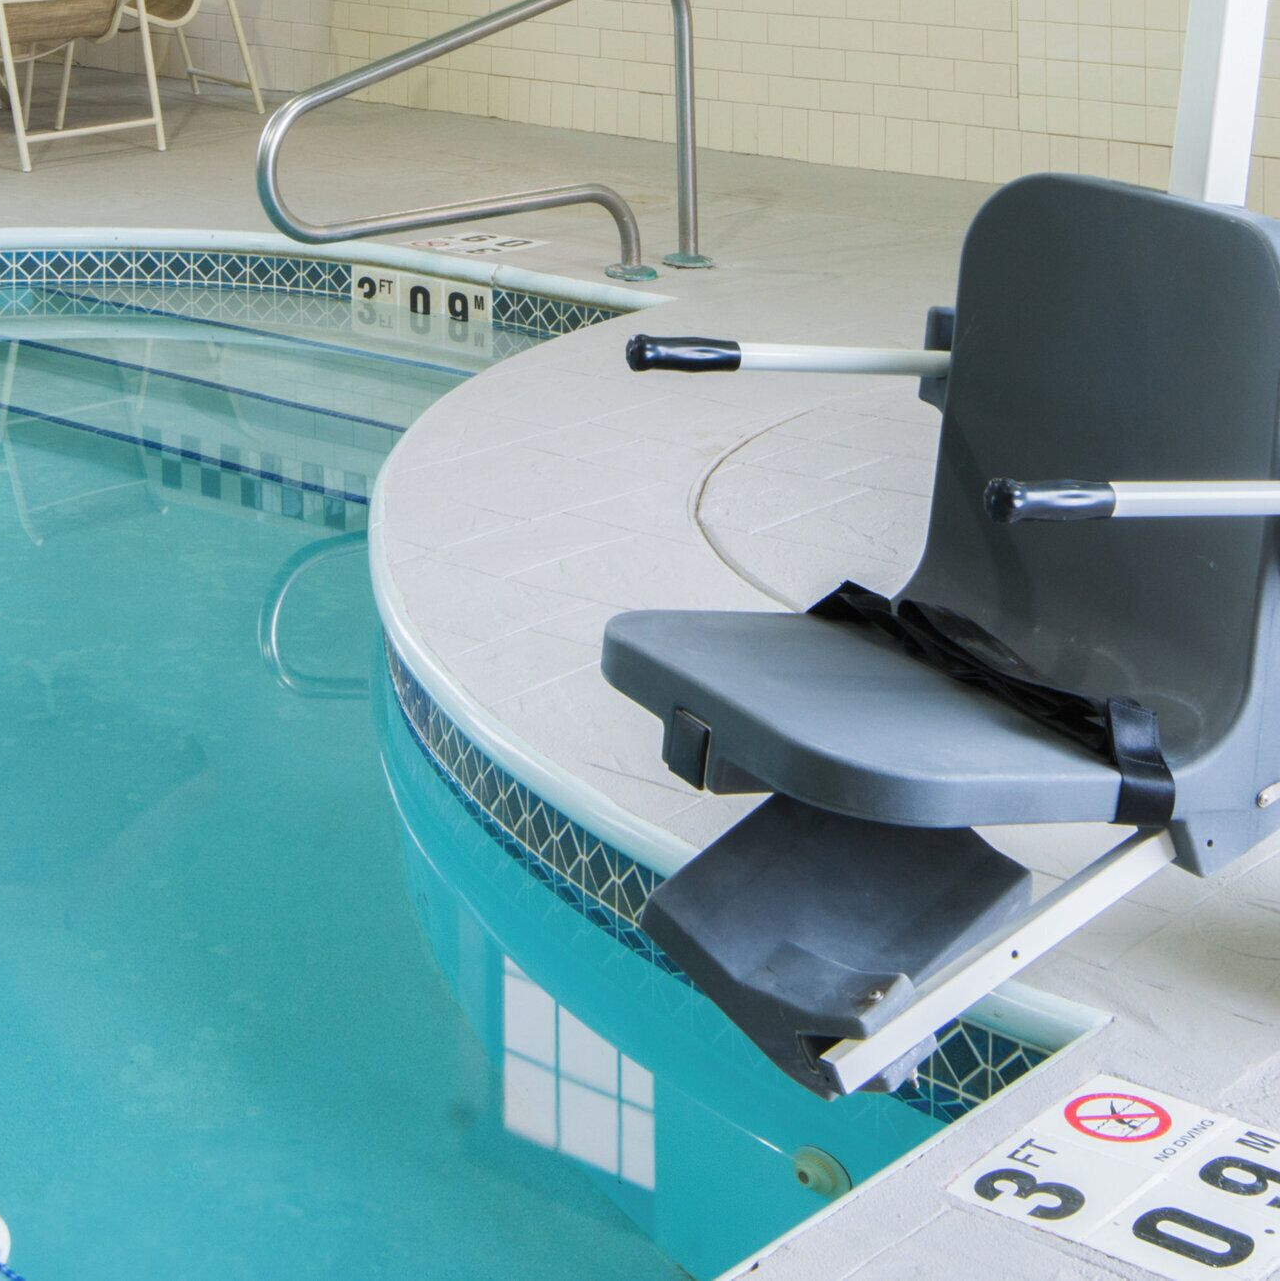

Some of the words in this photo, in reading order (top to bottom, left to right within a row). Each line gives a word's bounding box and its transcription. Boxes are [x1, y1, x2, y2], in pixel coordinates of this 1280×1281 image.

[379, 279, 393, 295] FT
[474, 295, 485, 311] M
[1006, 1138, 1058, 1168] FT
[1153, 1145, 1175, 1162] NO
[1175, 1118, 1216, 1150] DIVING
[973, 1167, 1086, 1221] 3
